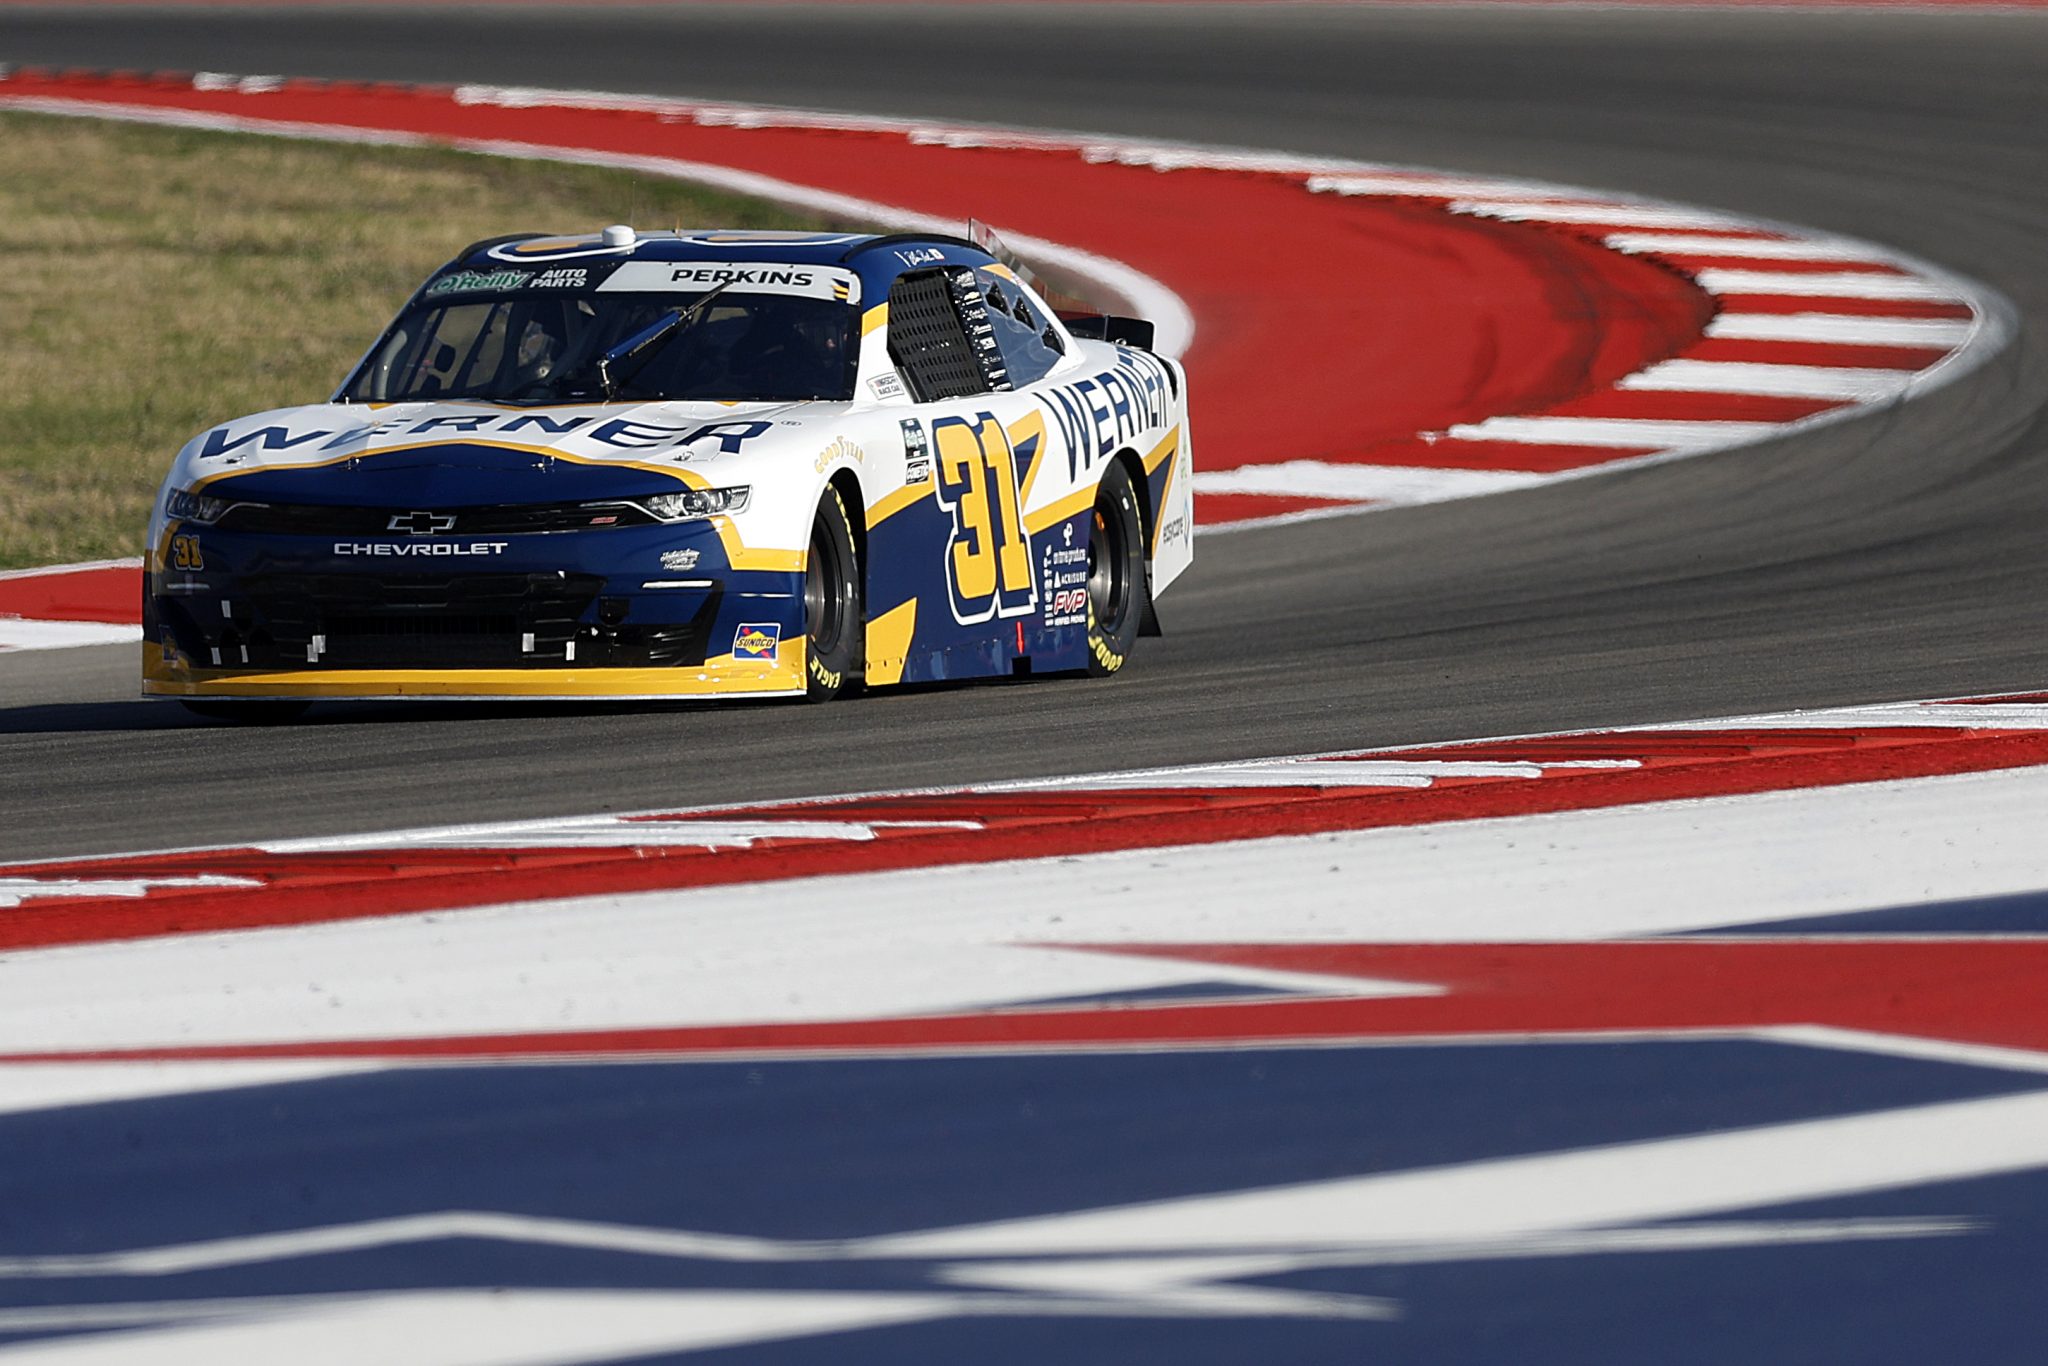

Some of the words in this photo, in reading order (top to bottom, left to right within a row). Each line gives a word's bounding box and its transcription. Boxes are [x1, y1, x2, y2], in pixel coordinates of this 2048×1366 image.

[529, 278, 586, 288] PARTS
[540, 269, 587, 279] AUTO
[671, 269, 813, 286] PERKINS
[1032, 346, 1168, 484] WERNER
[200, 414, 773, 454] WERNER
[814, 435, 864, 474] GOODYEAR
[932, 415, 1036, 618] 31
[174, 535, 204, 571] 31
[333, 542, 508, 556] CHEVROLET
[1054, 588, 1086, 616] FVP
[736, 637, 775, 648] SUNOCO
[809, 655, 841, 689] EAGLE
